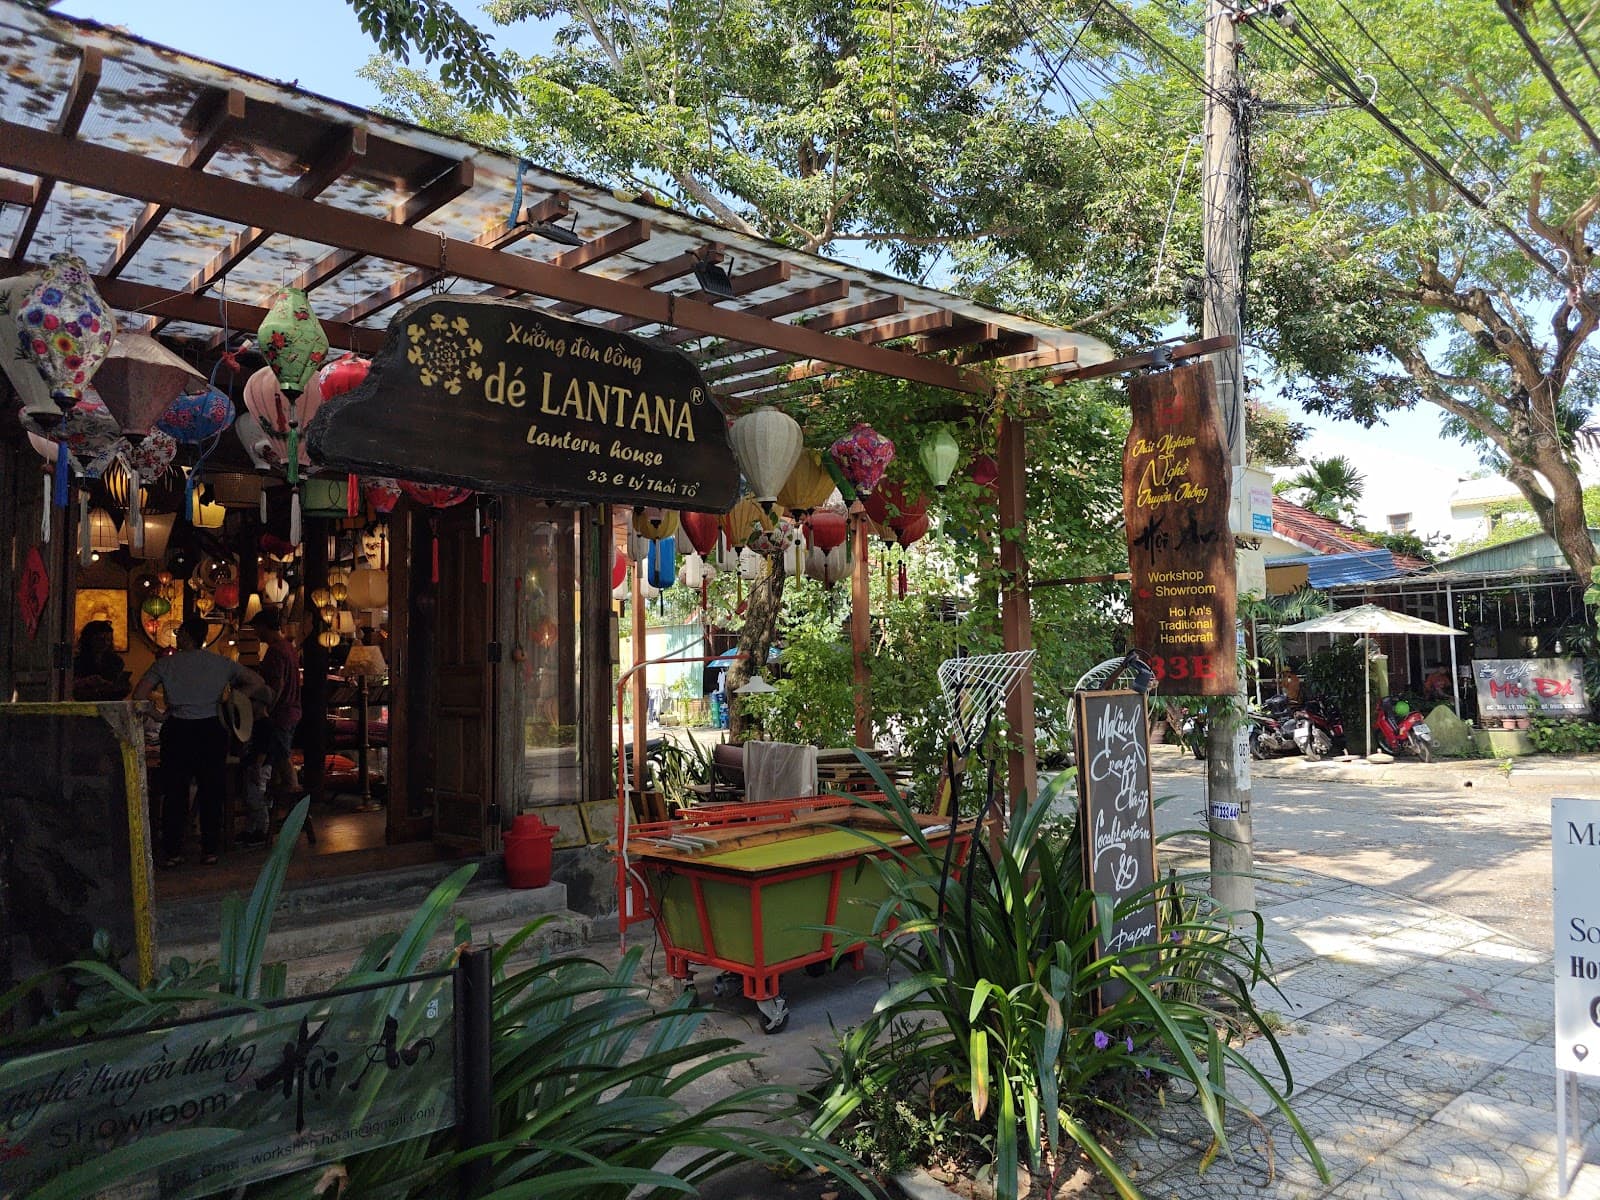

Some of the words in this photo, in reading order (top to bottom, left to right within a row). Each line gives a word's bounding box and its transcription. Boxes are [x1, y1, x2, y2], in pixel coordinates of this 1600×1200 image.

[570, 337, 600, 362] đèn
[484, 361, 527, 408] dé
[526, 425, 601, 455] Lantern
[609, 440, 663, 466] house
[587, 469, 608, 483] 33
[628, 473, 643, 491] Lý
[647, 478, 677, 495] Thái
[1148, 569, 1204, 583] Workshop
[1155, 584, 1216, 597] Showroom
[1169, 607, 1187, 617] Hoi
[1188, 605, 1213, 616] An's
[1158, 619, 1213, 631] Traditional
[1160, 632, 1214, 644] Handicraft
